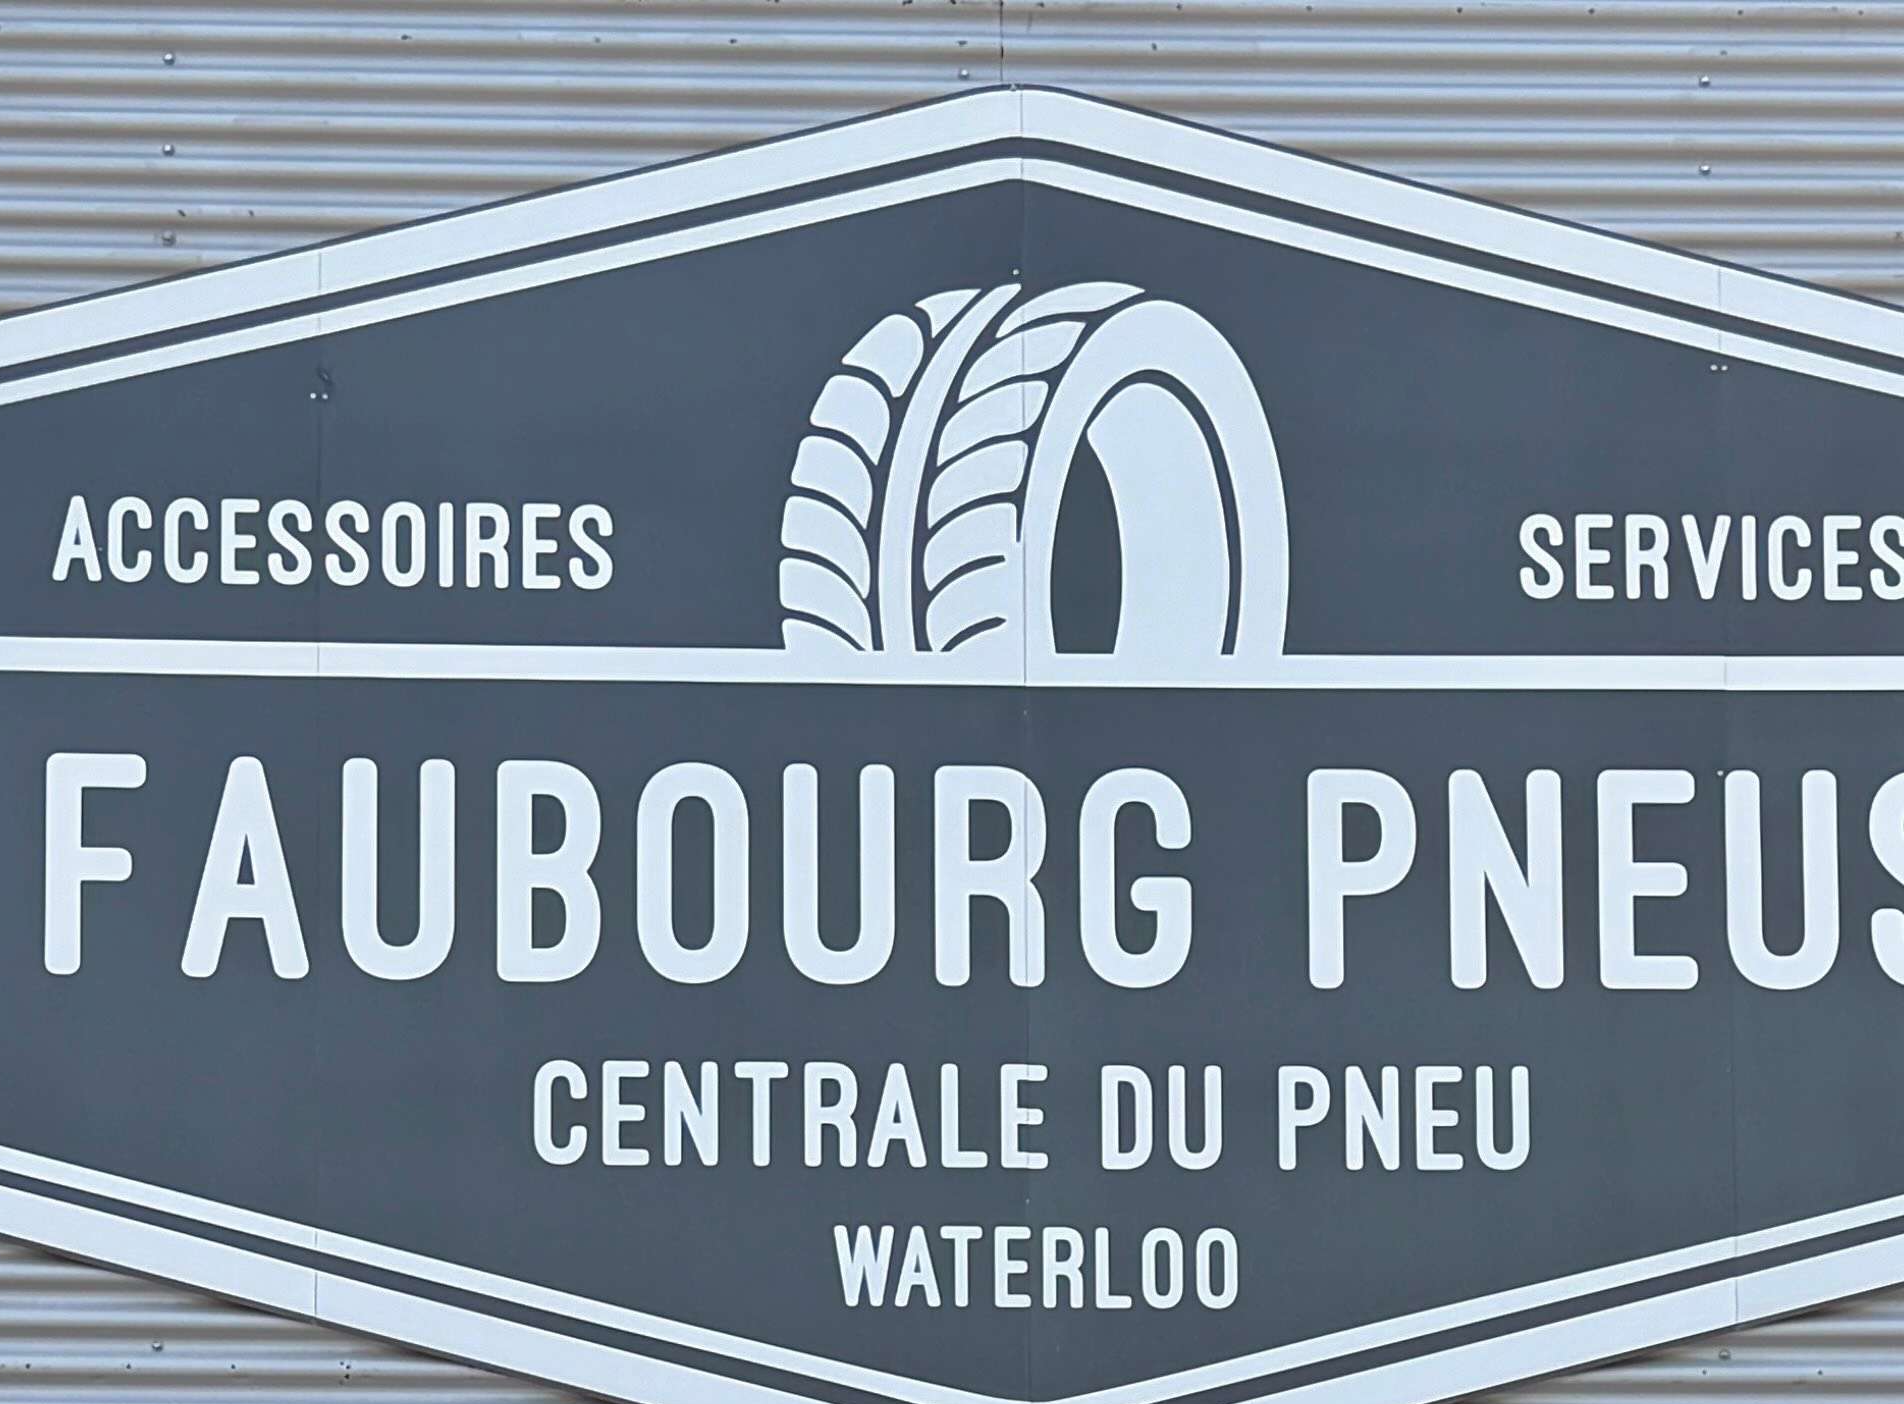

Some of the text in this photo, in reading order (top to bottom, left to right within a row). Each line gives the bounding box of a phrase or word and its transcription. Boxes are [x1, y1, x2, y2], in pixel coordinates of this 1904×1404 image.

[52, 495, 614, 589] ACCESSOIRES
[44, 752, 1193, 989] FAUBOURG
[532, 1059, 1532, 1171] CENTRALE DU PNEU
[833, 1223, 1239, 1310] WATERLOO
